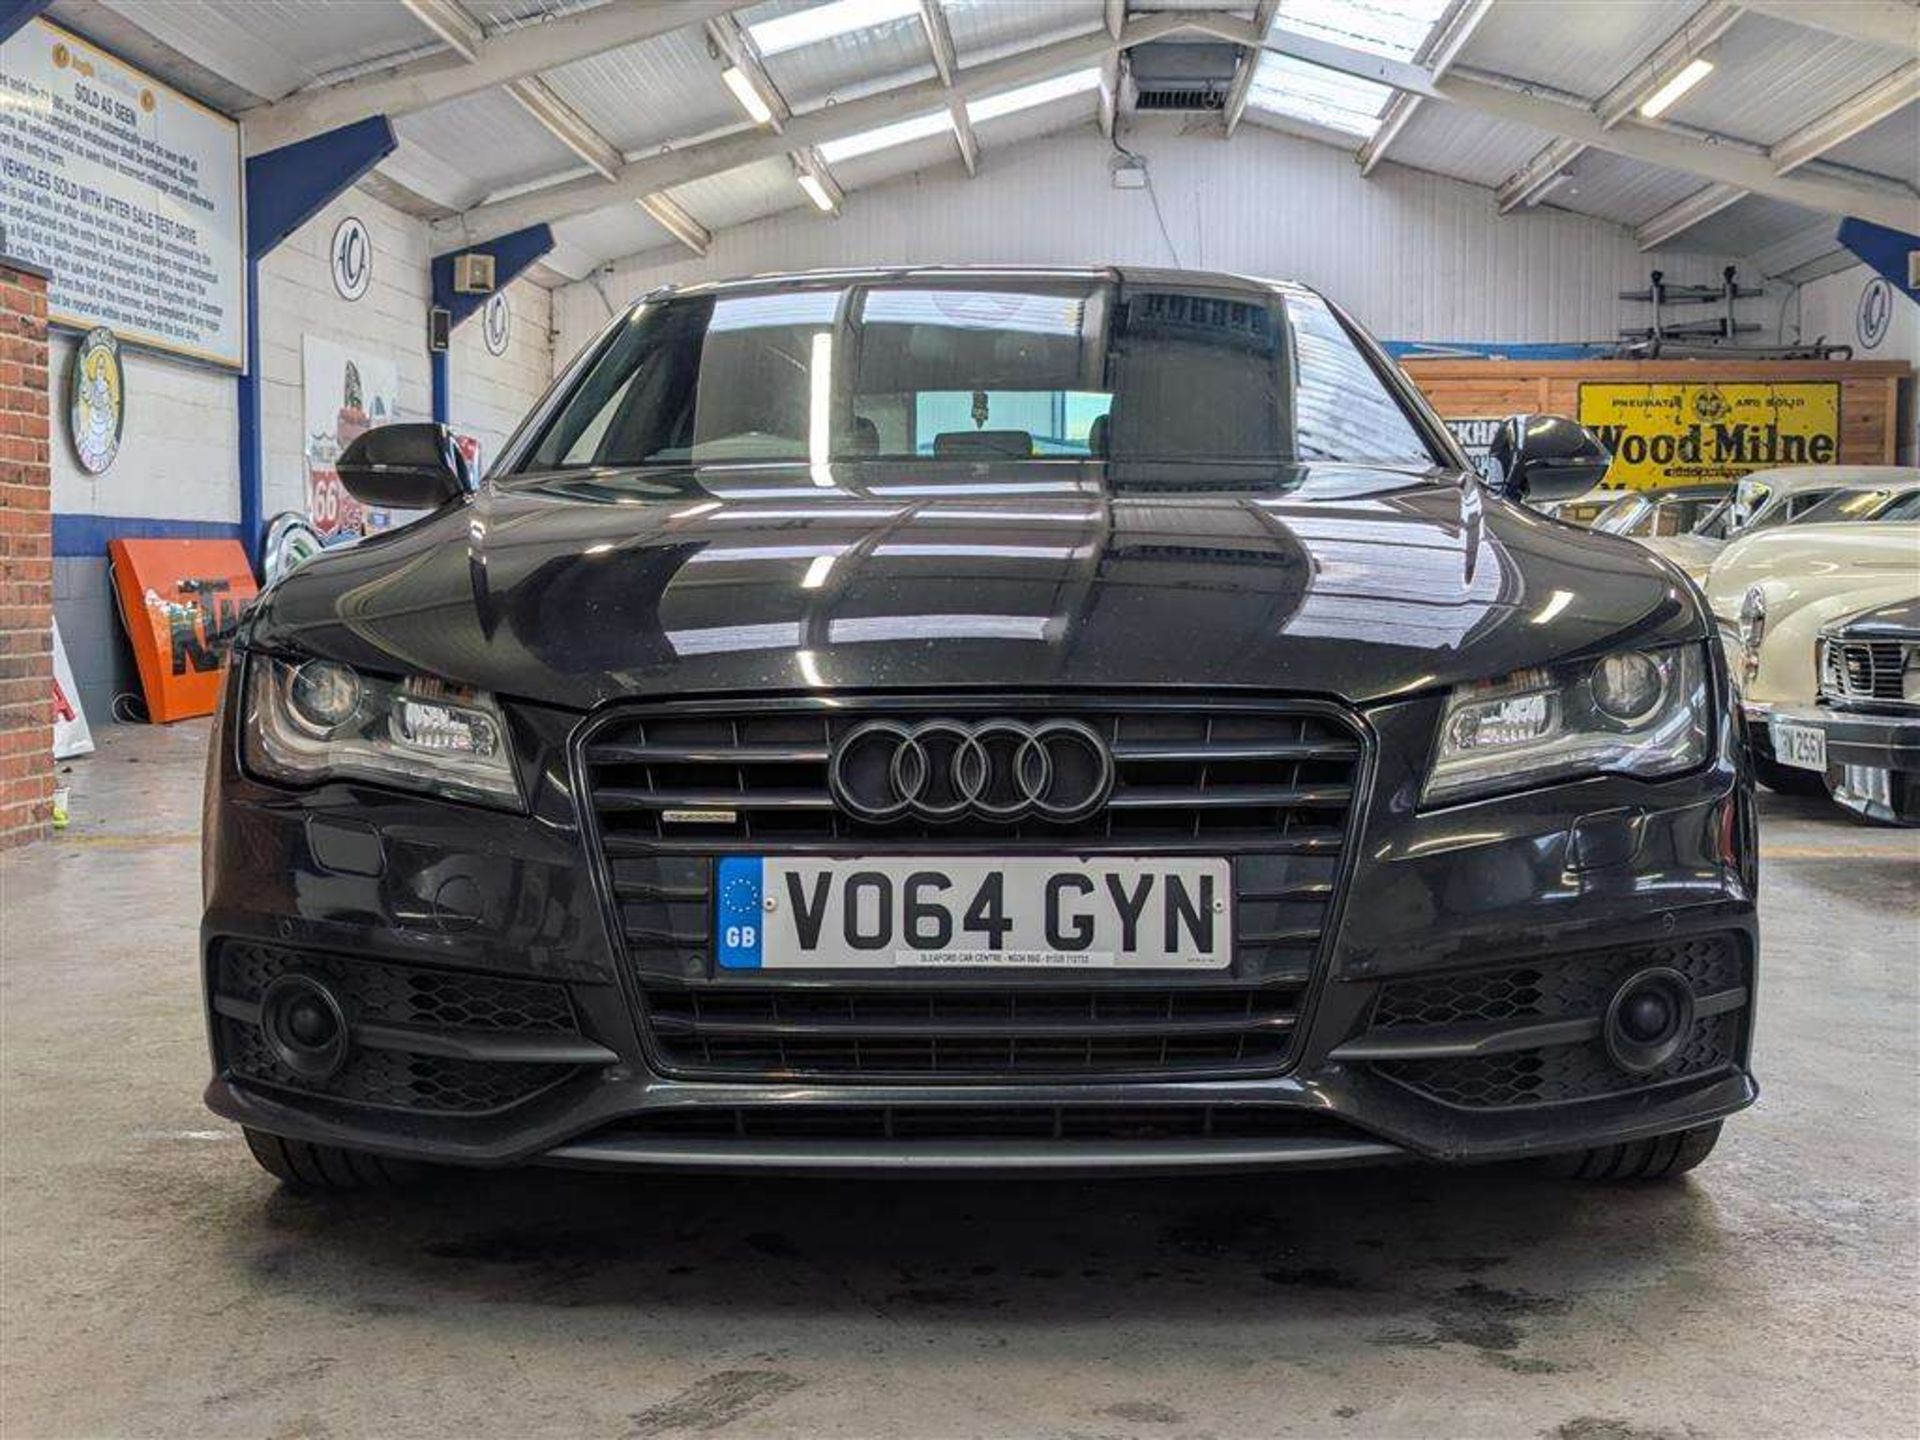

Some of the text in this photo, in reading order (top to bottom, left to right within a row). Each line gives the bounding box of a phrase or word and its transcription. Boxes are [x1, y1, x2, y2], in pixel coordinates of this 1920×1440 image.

[74, 82, 136, 127] SOLD AS SEEN
[12, 135, 24, 151] the
[1, 155, 51, 192] VEHICLES
[53, 175, 77, 202] SOLD
[79, 185, 102, 211] WITH
[104, 195, 130, 221] AFTER
[132, 205, 153, 230] SALE
[153, 213, 173, 237] TEST
[18, 188, 35, 205] sold
[785, 871, 1214, 953] VO64 GYN
[726, 926, 756, 949] GB
[960, 953, 973, 963] CAR
[974, 953, 1002, 963] CENTRE
